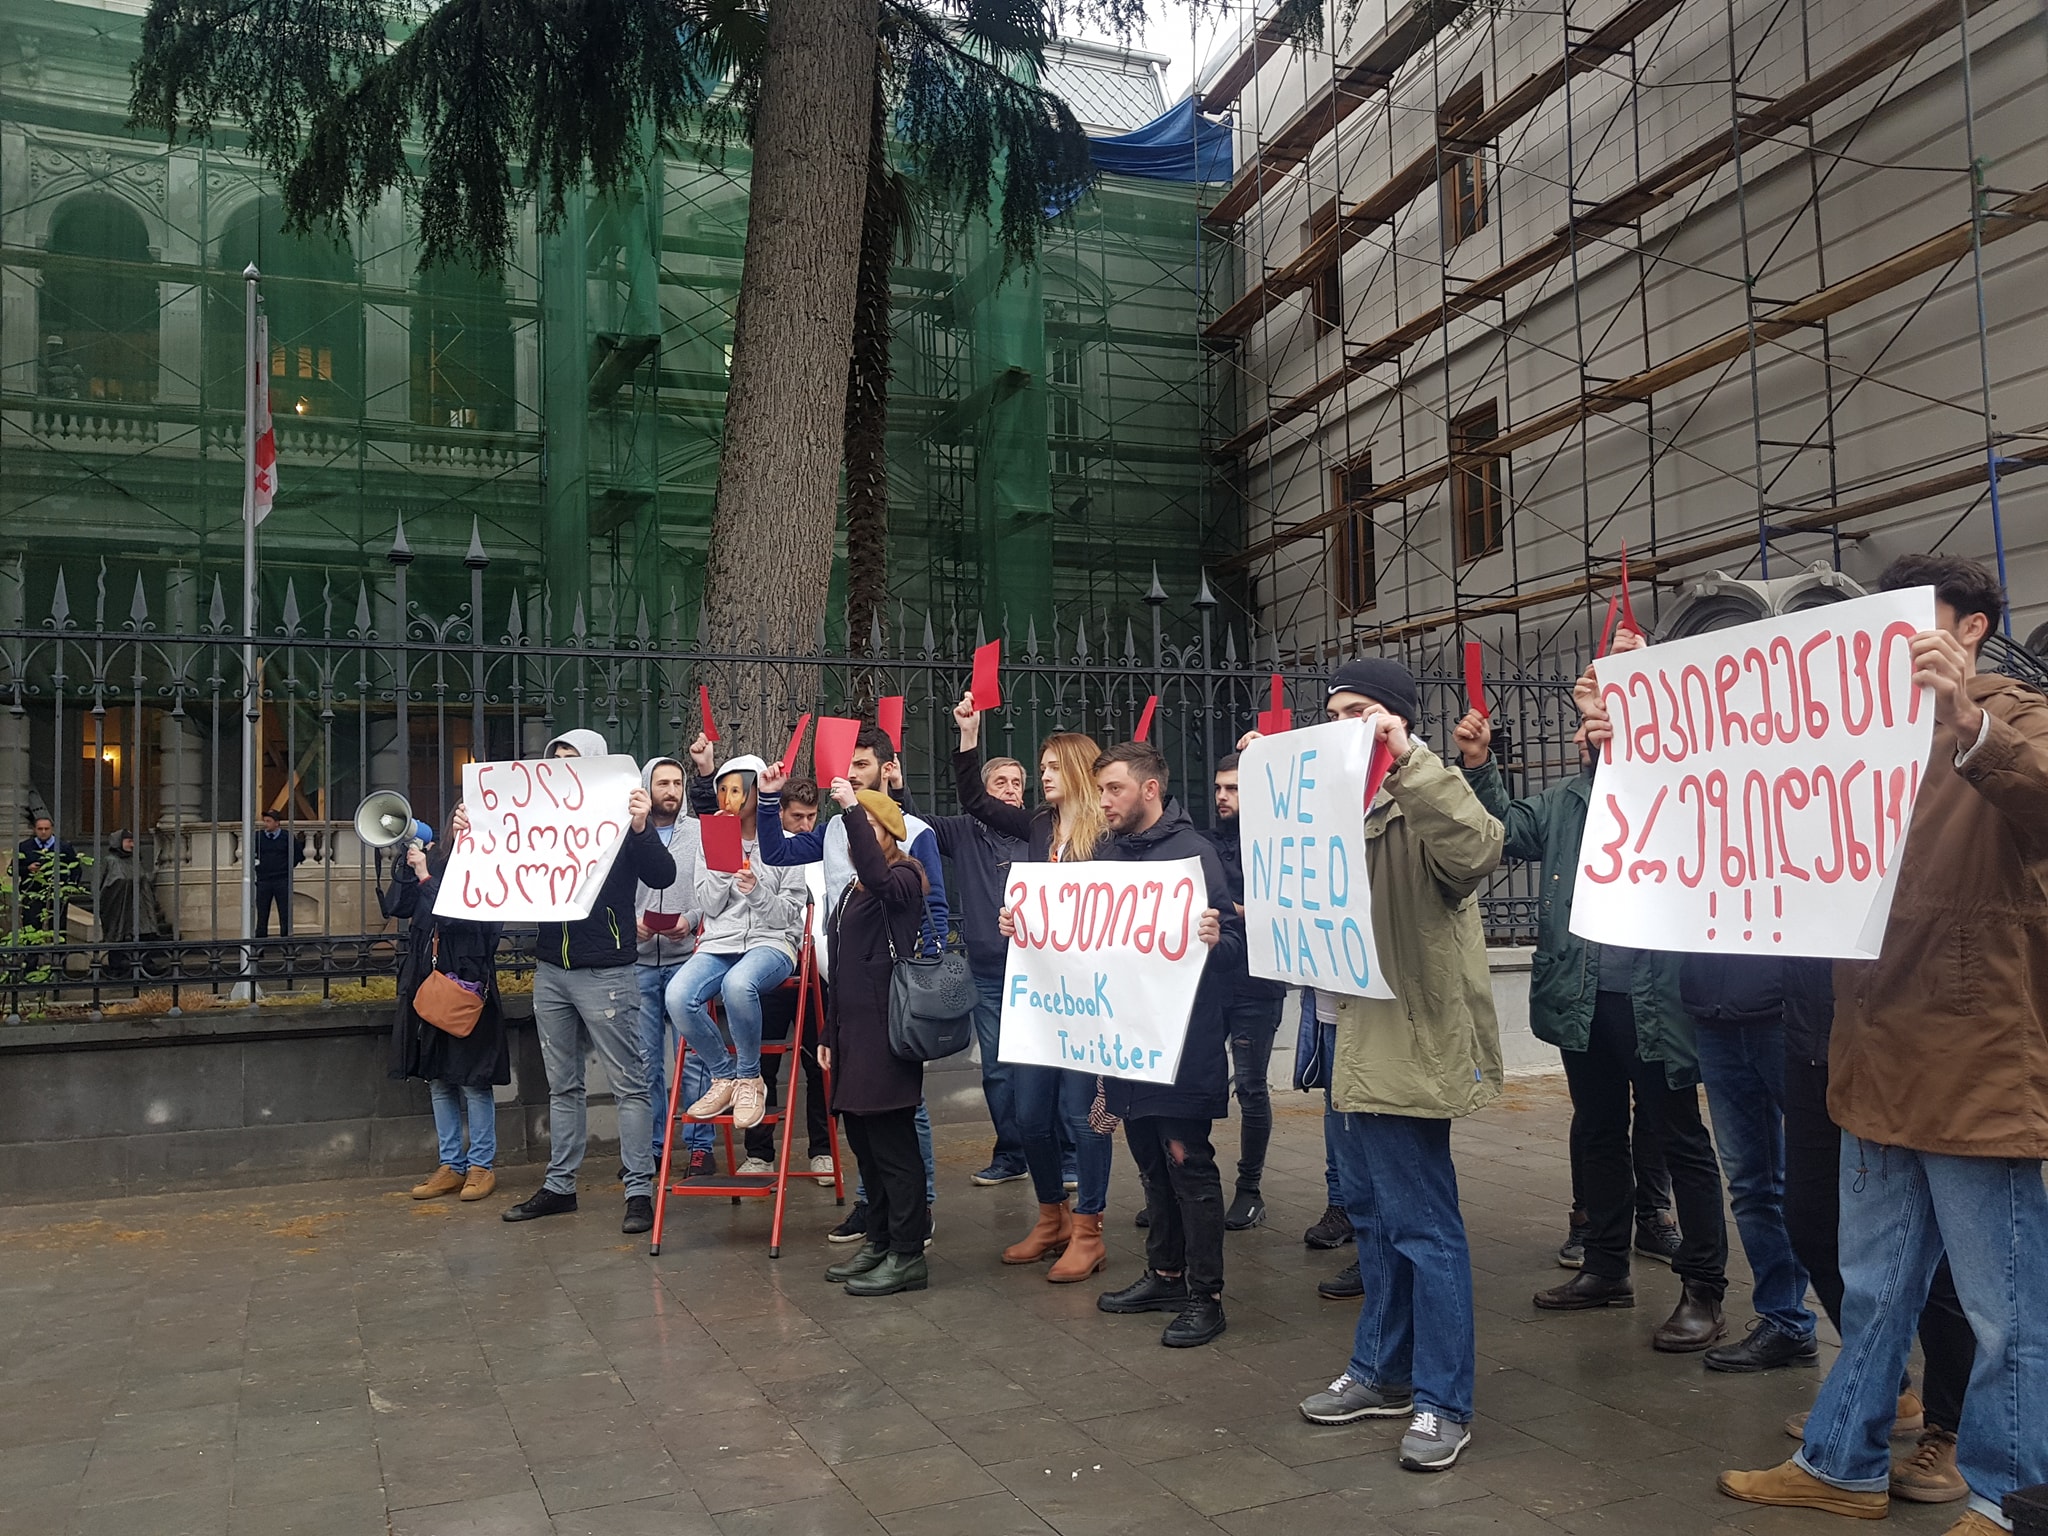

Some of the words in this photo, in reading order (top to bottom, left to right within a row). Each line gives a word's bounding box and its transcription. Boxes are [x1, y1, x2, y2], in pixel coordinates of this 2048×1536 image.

[478, 762, 584, 811] ნელა
[1266, 750, 1317, 823] WE
[463, 860, 598, 909] სალო
[1253, 835, 1349, 910] NEED
[1009, 877, 1194, 962] გაუთიშე
[1272, 917, 1369, 989] NATO
[1058, 1030, 1163, 1070] Twitter
